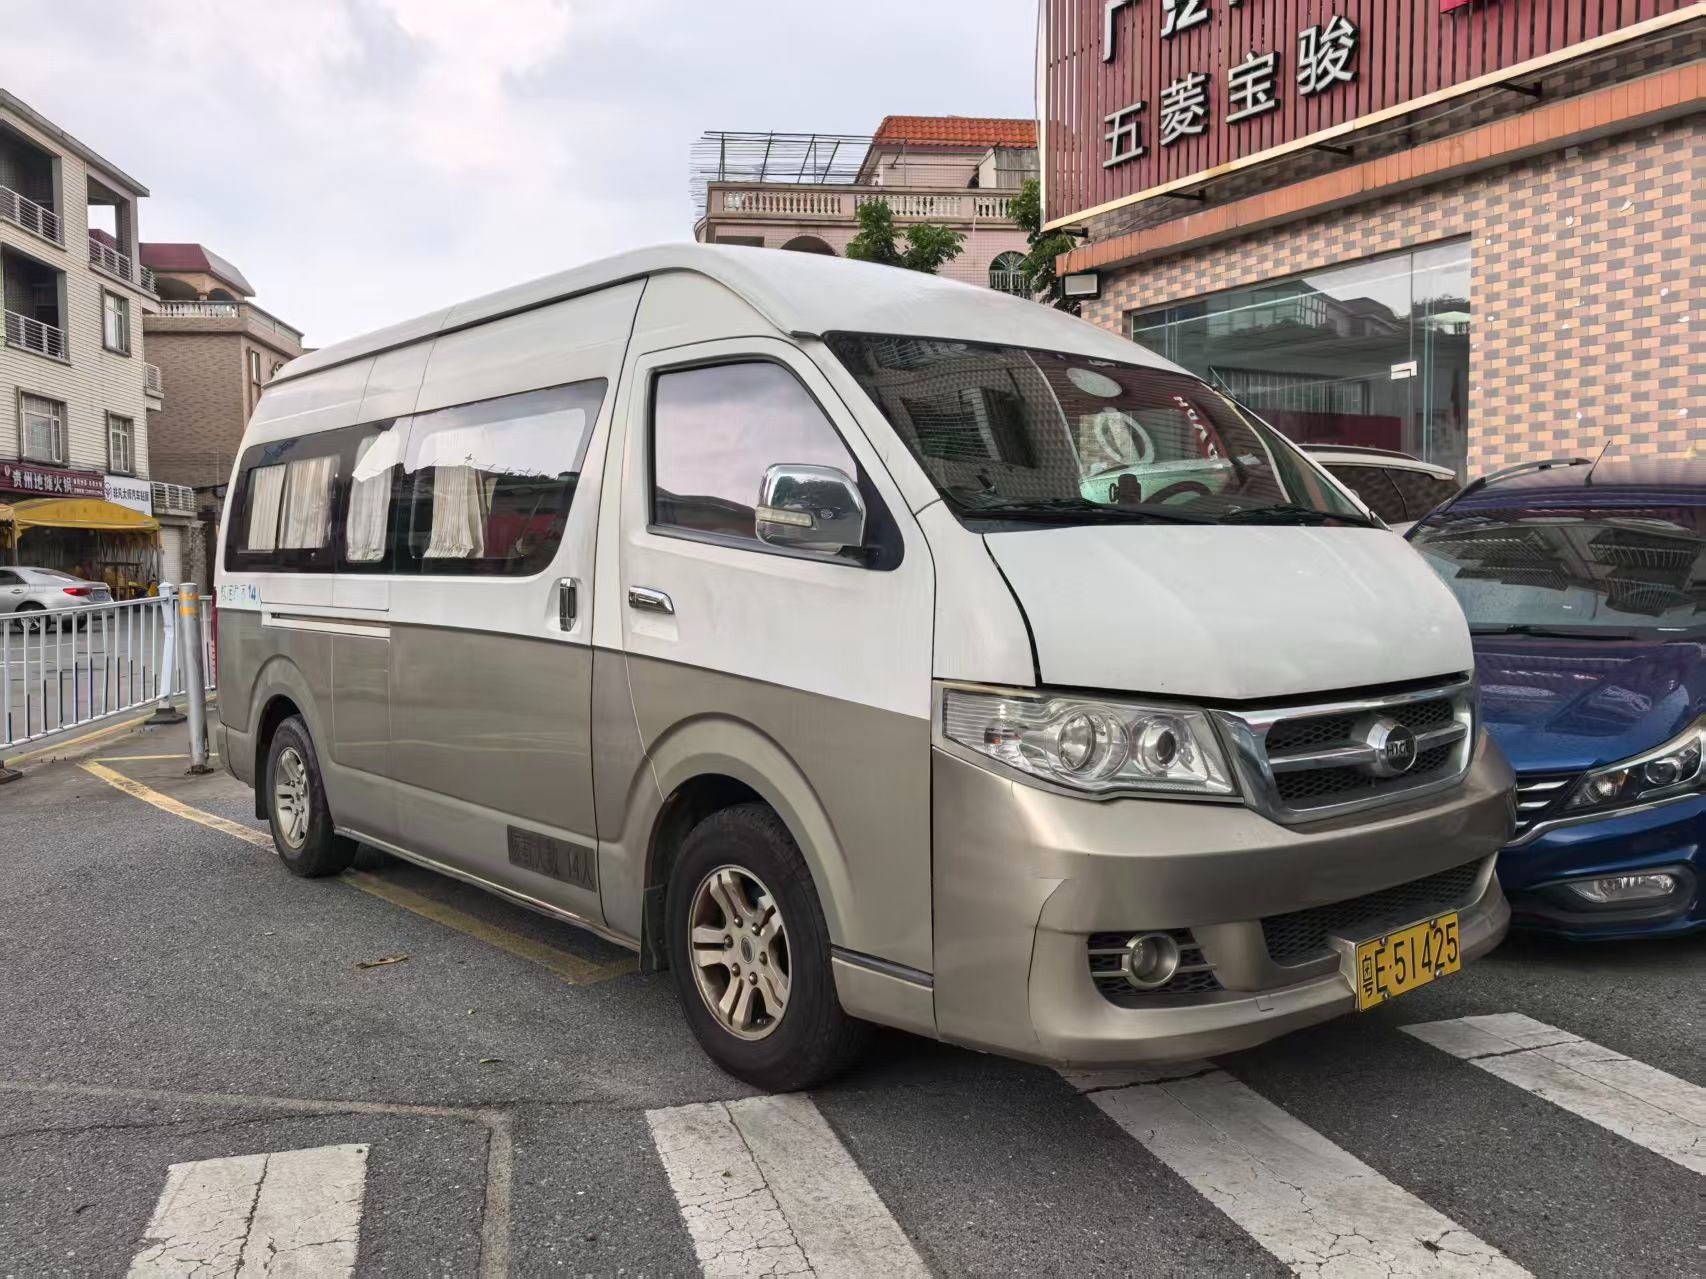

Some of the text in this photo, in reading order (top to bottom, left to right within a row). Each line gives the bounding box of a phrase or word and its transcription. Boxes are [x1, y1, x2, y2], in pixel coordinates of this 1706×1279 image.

[1104, 15, 1357, 169] 五菱宝骏
[12, 470, 72, 493] 贵州地摊火锅
